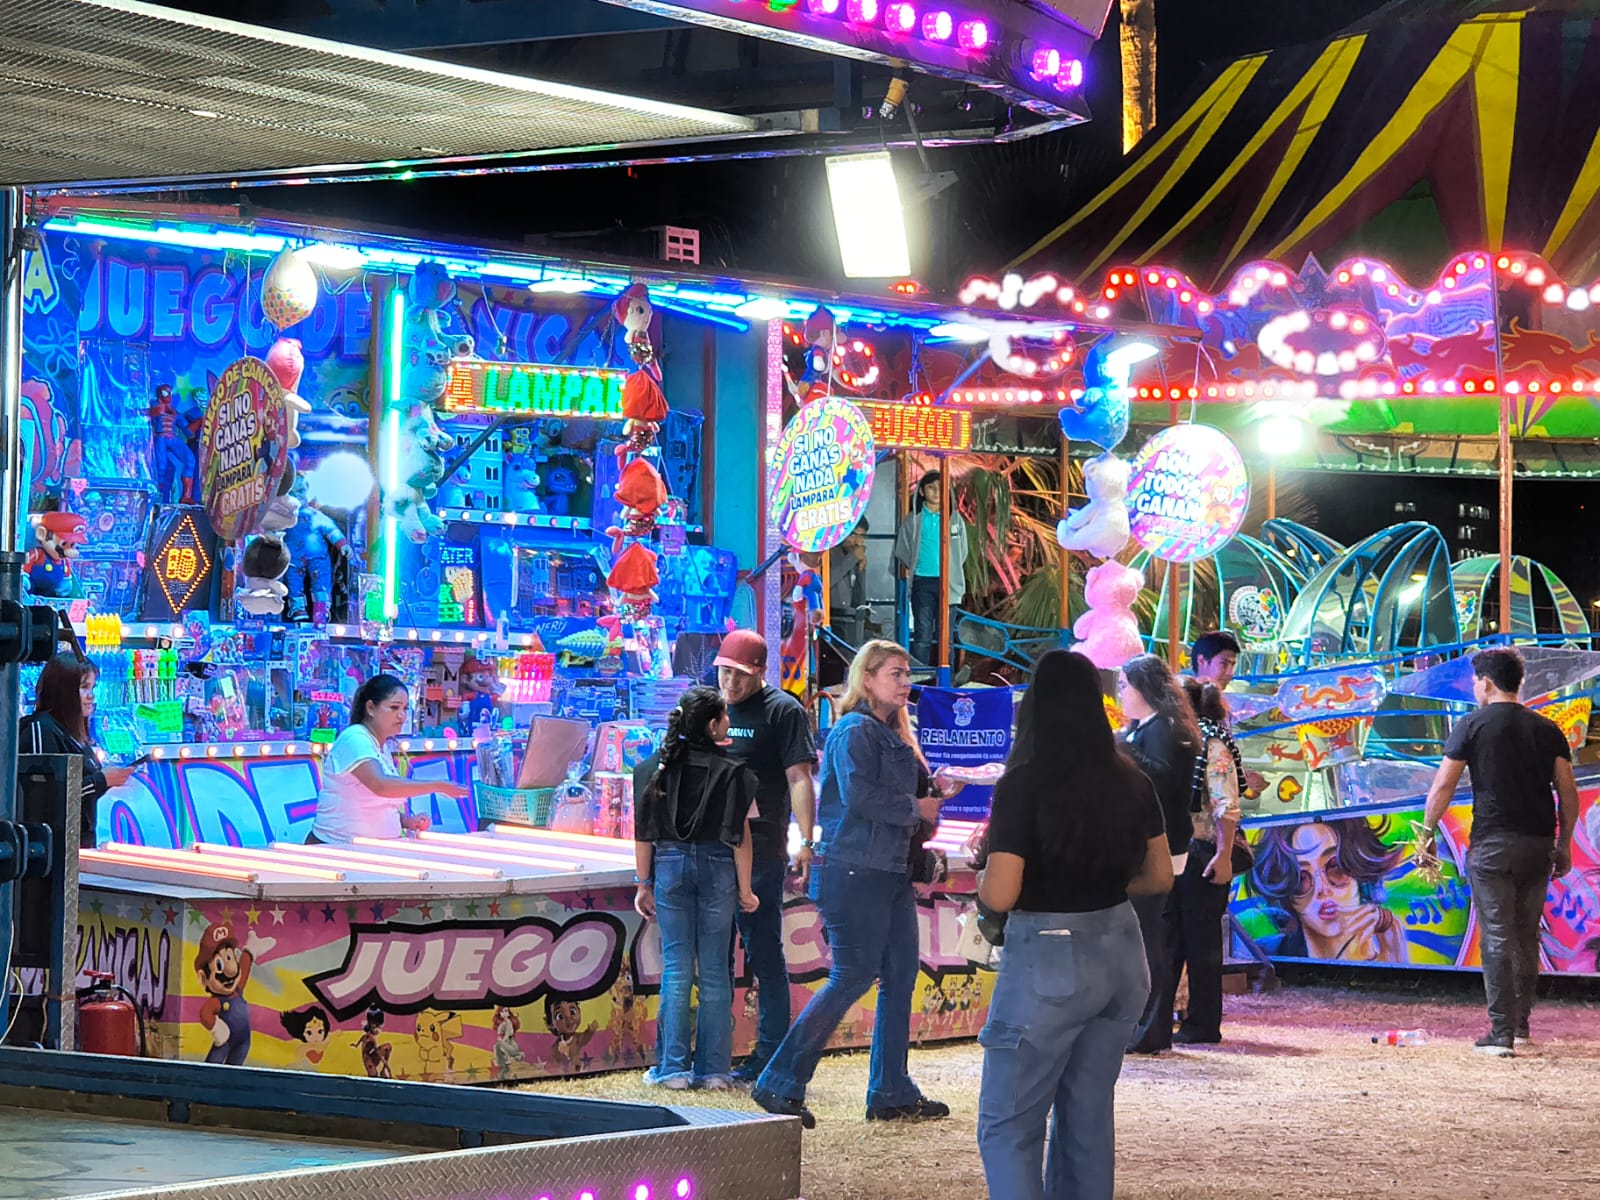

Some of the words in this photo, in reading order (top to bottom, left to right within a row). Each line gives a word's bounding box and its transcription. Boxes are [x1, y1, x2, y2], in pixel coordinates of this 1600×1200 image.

[202, 382, 226, 447] JUEGO
[225, 362, 240, 388] DE
[218, 400, 231, 426] SI
[233, 391, 251, 418] NO
[215, 413, 256, 452] GANAS
[773, 416, 803, 471] JUEGO
[804, 405, 822, 421] DE
[793, 433, 810, 454] SI
[813, 427, 835, 449] NO
[219, 441, 252, 475] NADA
[789, 445, 841, 475] GANAS
[220, 477, 266, 516] GRATIS
[794, 467, 835, 494] NADA
[1143, 472, 1202, 501] TODOS
[791, 488, 835, 510] LAMPARA
[796, 500, 850, 531] GRATIS
[921, 728, 1006, 746] REGLAMENTO
[324, 923, 613, 1002] JUEGO
